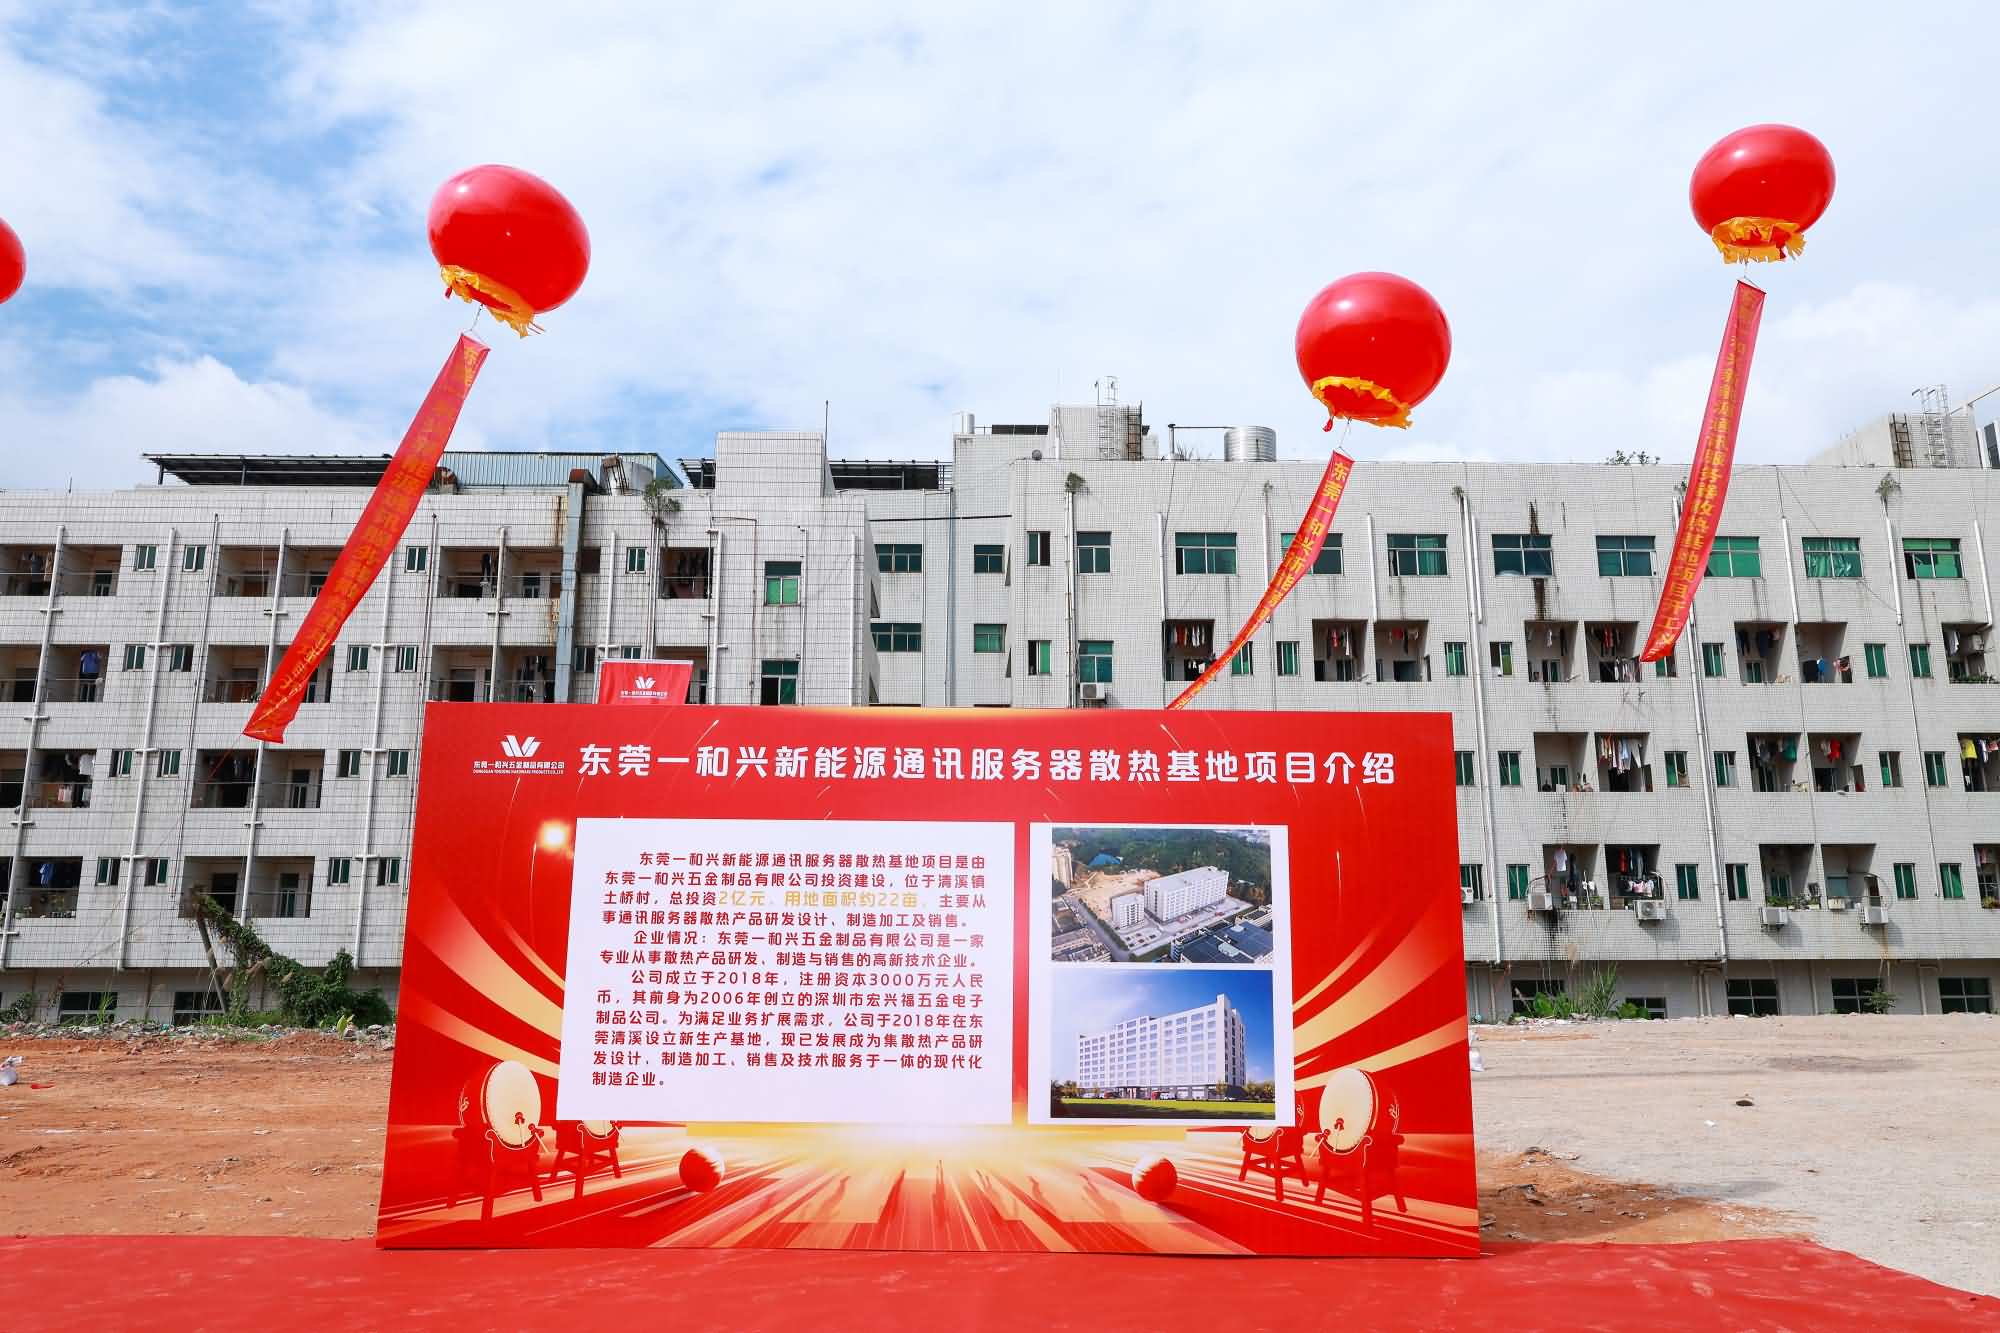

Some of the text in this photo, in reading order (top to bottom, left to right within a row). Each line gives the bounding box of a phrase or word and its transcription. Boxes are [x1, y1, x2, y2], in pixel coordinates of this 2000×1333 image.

[578, 743, 1394, 784] 东莞一和兴新能源通讯服务器散热基地项目介绍
[639, 851, 985, 870] 东莞一和兴新能源通讯服务器散热基地项目是由
[591, 1071, 665, 1089] 制造企业。
